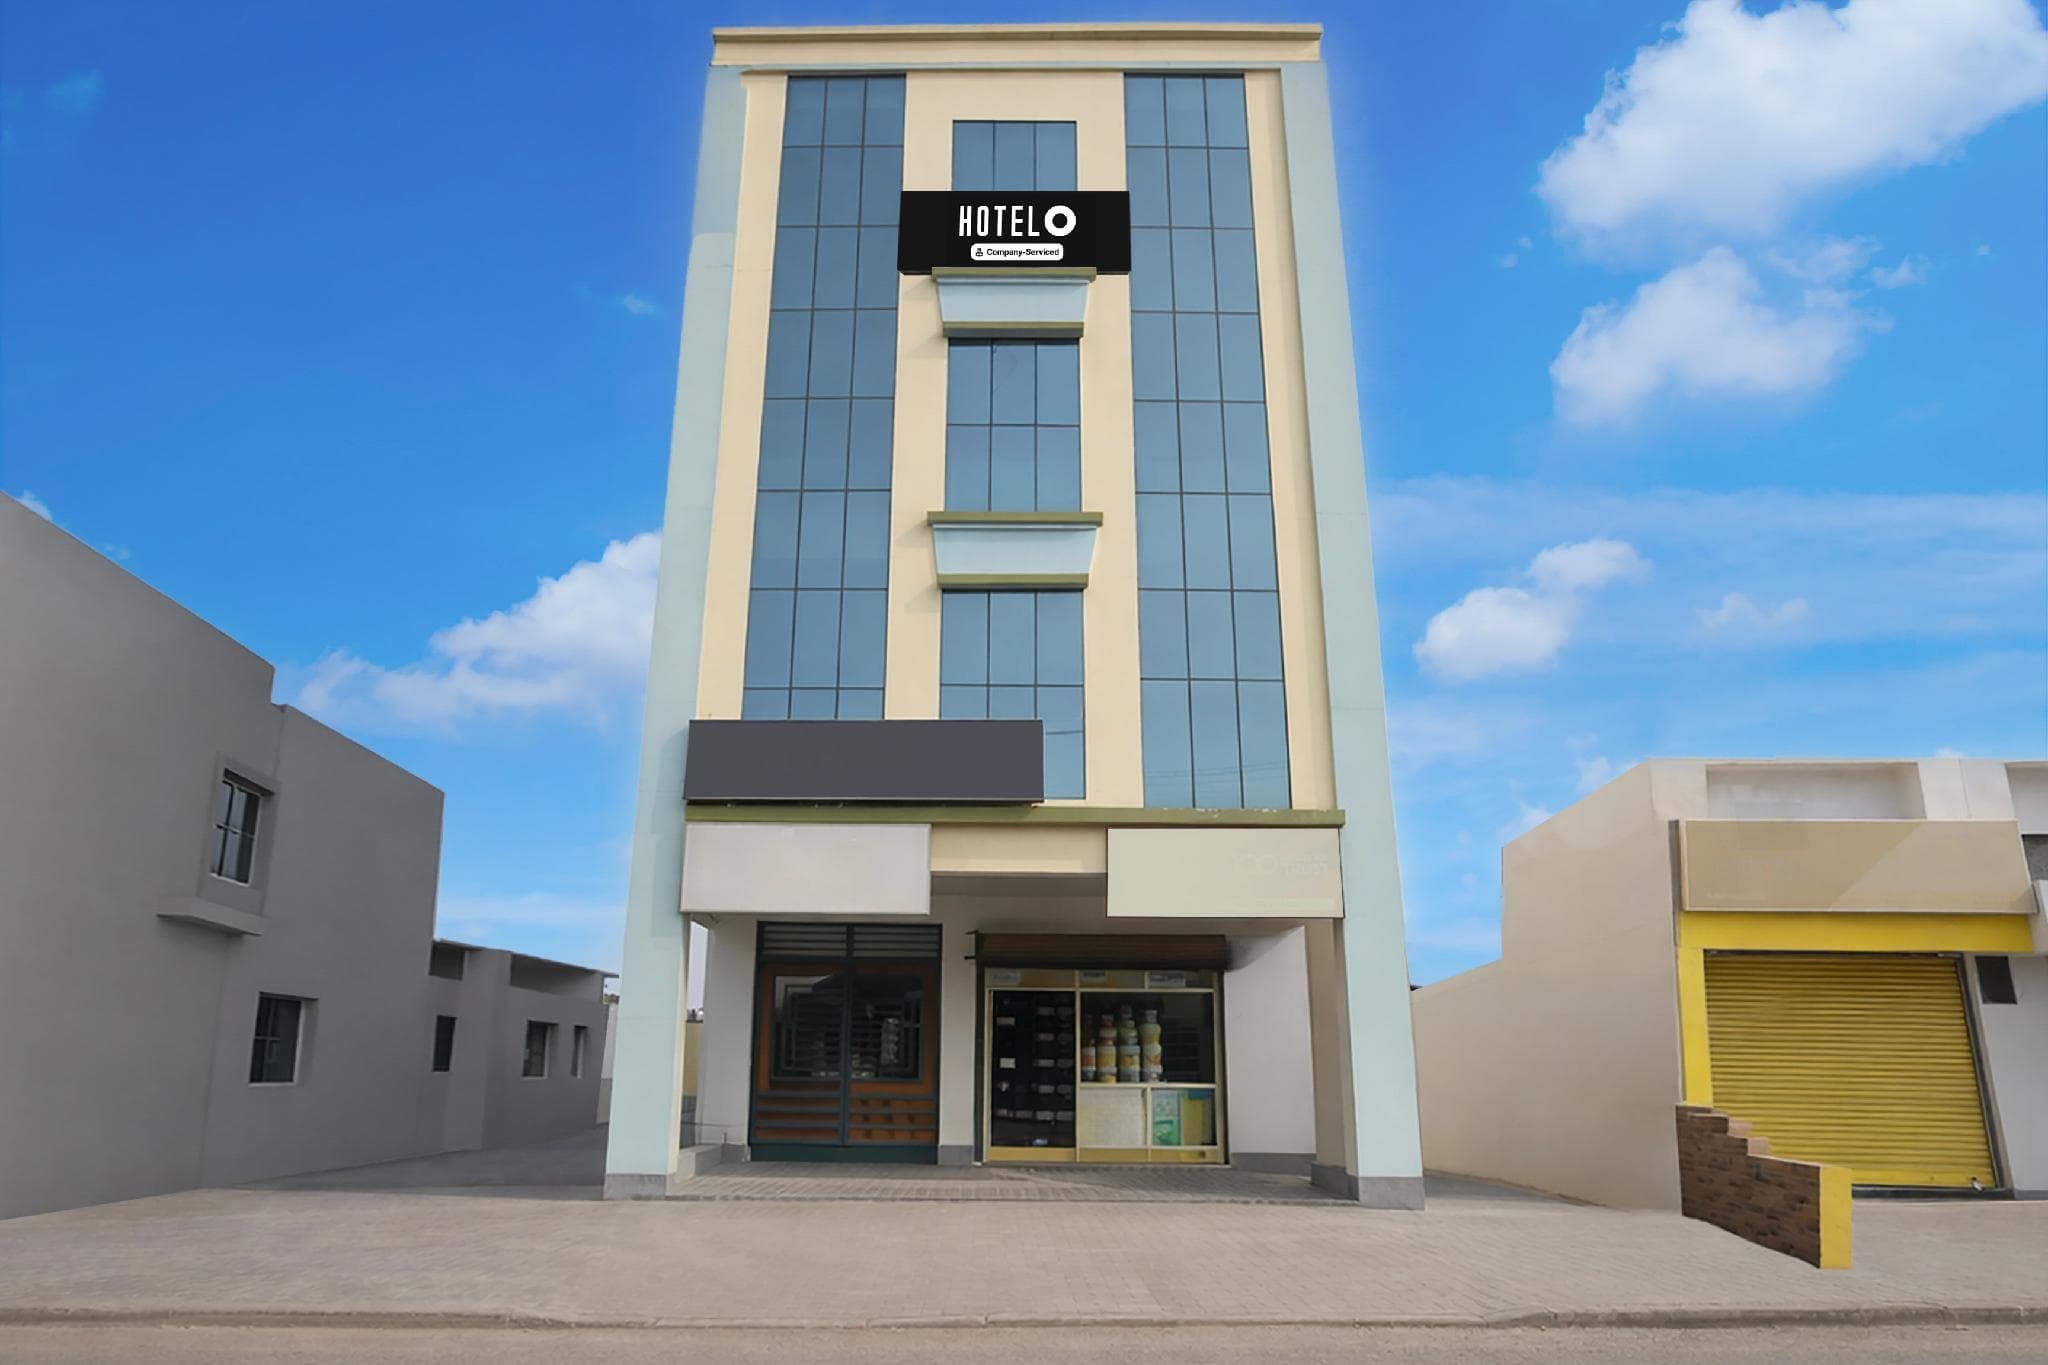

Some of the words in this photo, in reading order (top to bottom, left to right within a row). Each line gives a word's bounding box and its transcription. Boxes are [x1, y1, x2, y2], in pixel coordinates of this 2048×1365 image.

[958, 205, 1040, 237] HOTEL
[1044, 205, 1077, 237] O
[986, 248, 1060, 258] Company-Serviced
